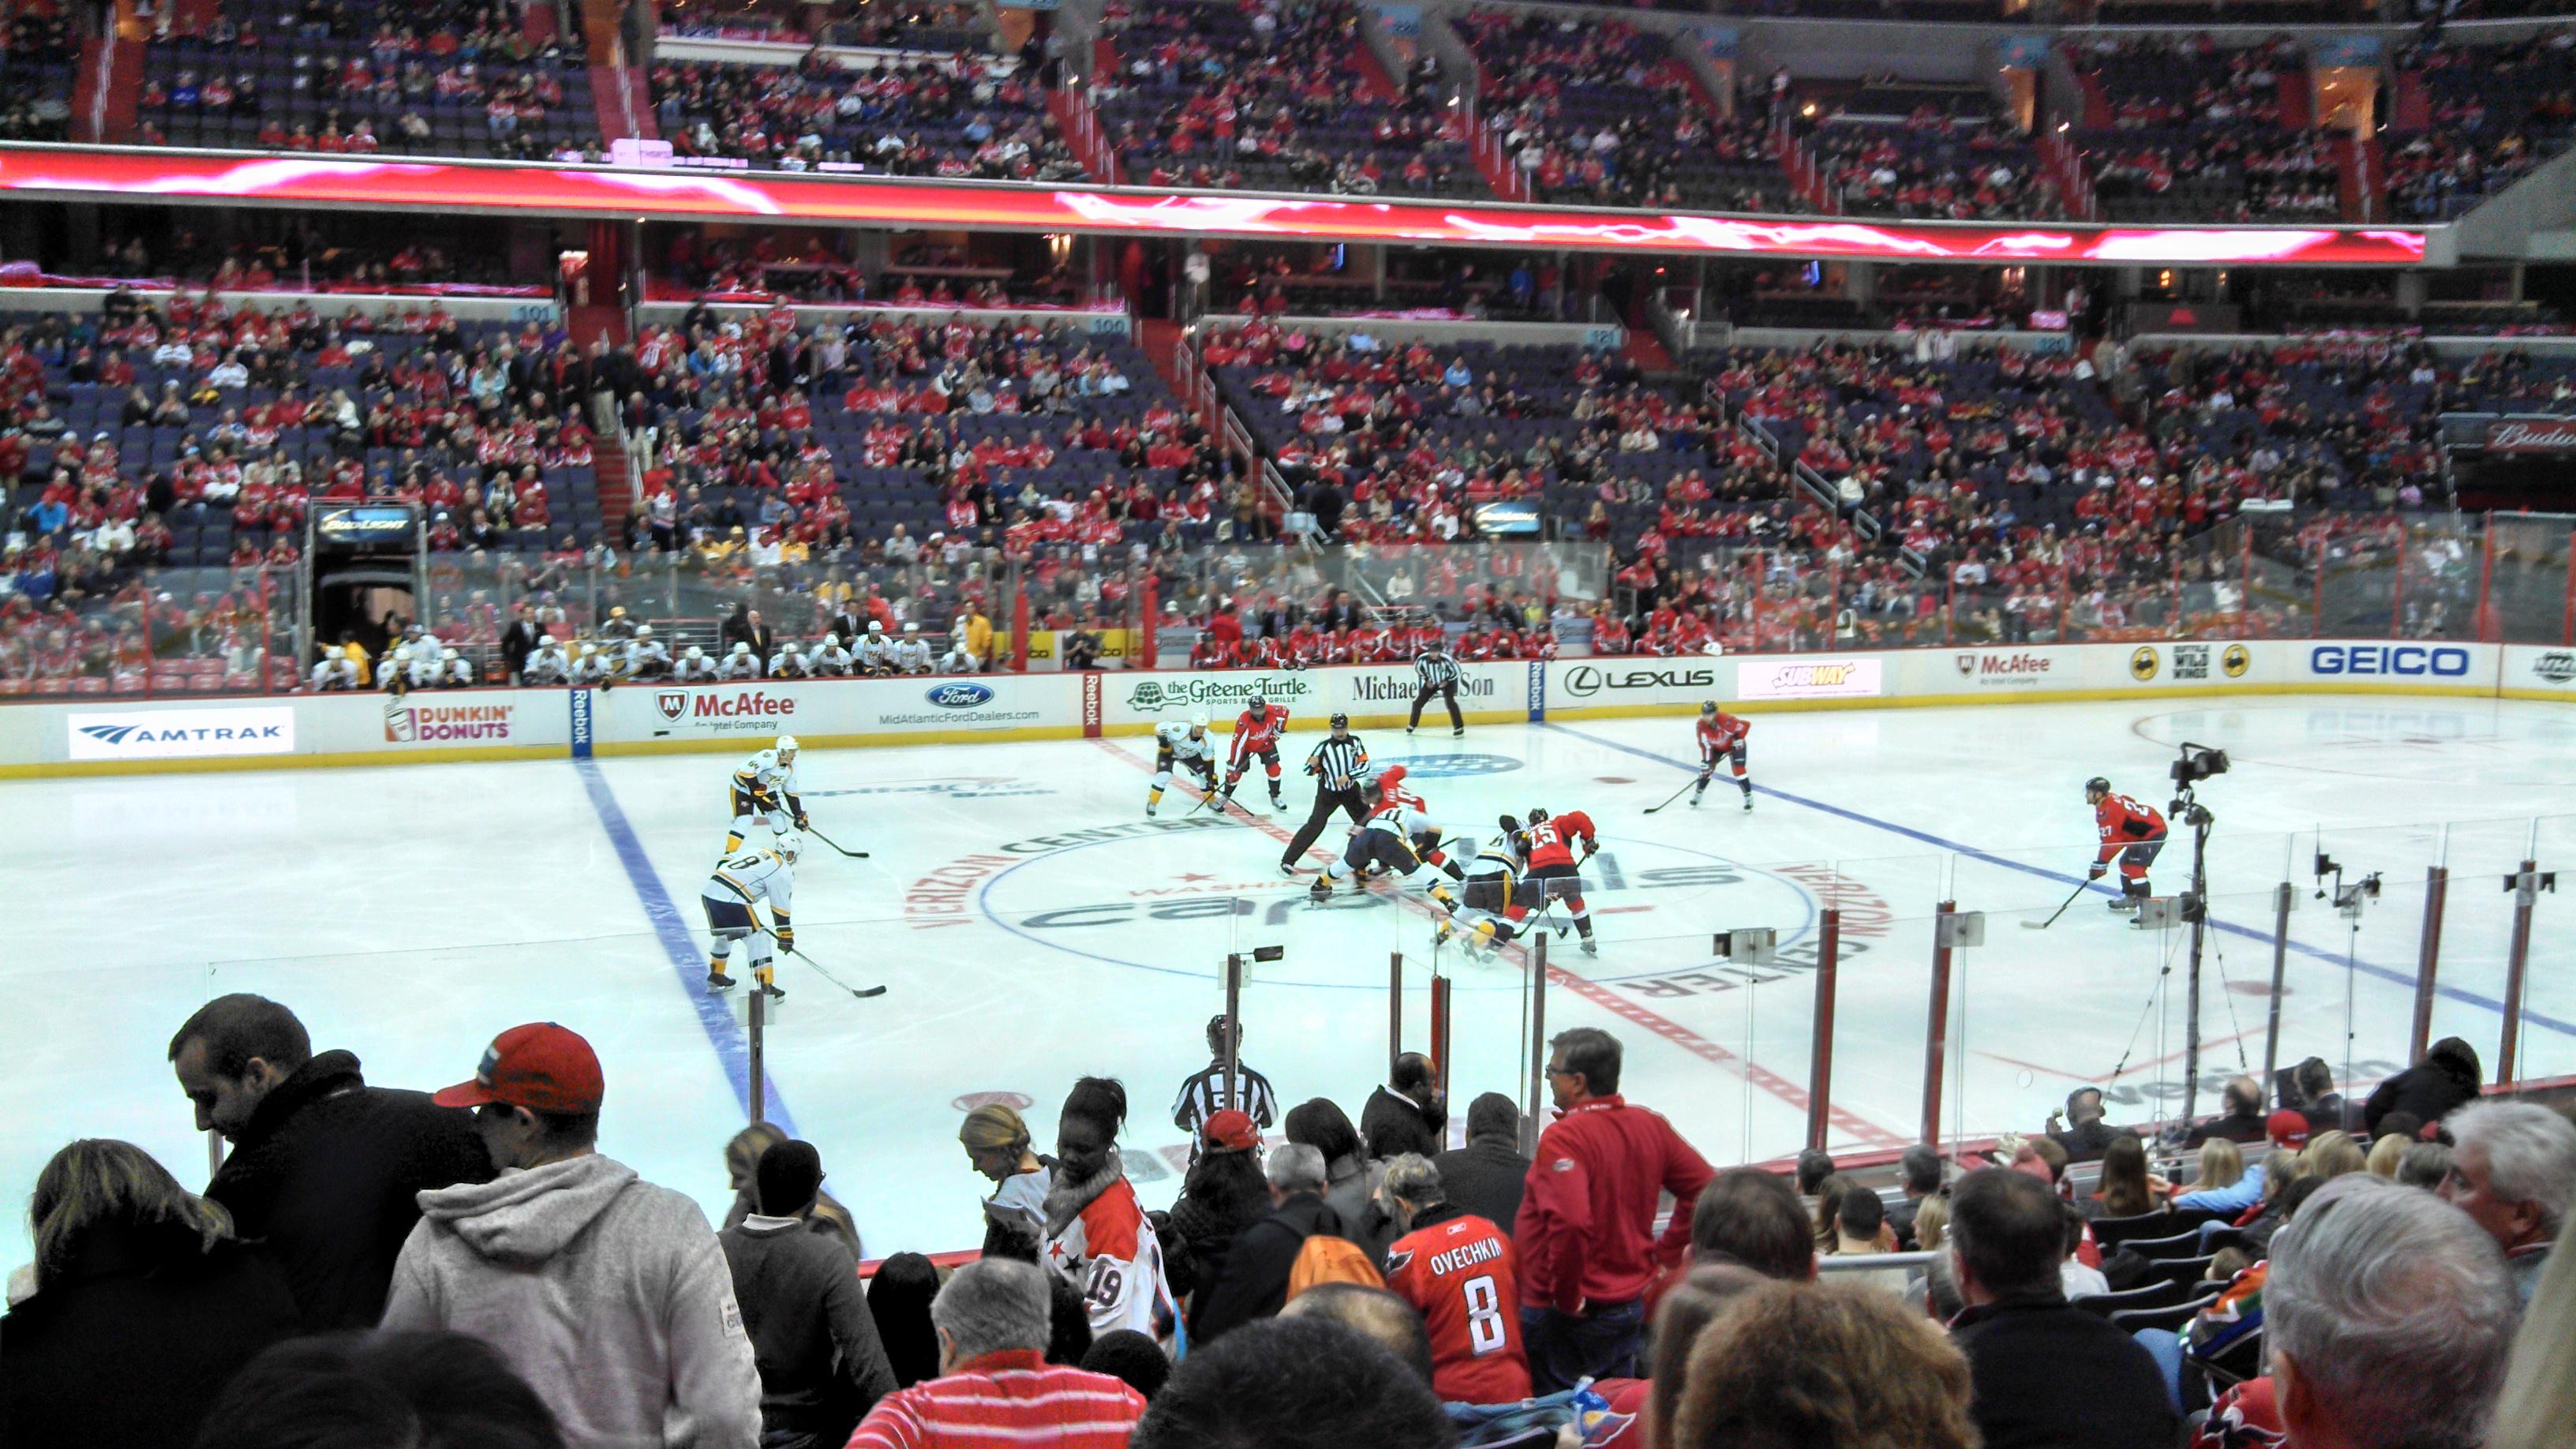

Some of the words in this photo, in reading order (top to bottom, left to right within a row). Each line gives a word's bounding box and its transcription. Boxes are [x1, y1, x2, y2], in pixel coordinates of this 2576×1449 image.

[1981, 653, 2050, 673] McAfee
[2311, 646, 2469, 676] GEICO
[1352, 676, 1420, 701] Michae
[1460, 672, 1494, 696] Son
[1530, 661, 1539, 710] Reebok
[1606, 670, 1713, 689] LEXUS
[1773, 663, 1855, 688] SUBWAY
[938, 686, 981, 704] Ford
[1086, 674, 1098, 726] Reebok
[1168, 681, 1188, 694] the
[1189, 680, 1253, 703] Greene
[1253, 678, 1306, 695] Turtle
[419, 706, 513, 723] DUNKIN'
[573, 689, 590, 744] Reebok
[695, 692, 795, 717] McAfee
[734, 721, 777, 730] Company
[879, 711, 1039, 725] MidAtlanticFordDealers.com
[136, 725, 281, 742] AMTRAK
[420, 723, 509, 740] DONUTS
[904, 855, 1020, 930] VERIZON
[1001, 817, 1235, 854] CENTER
[1431, 1237, 1503, 1275] OVECHKIN
[1087, 1263, 1121, 1307] 19
[1463, 1275, 1506, 1356] 8
